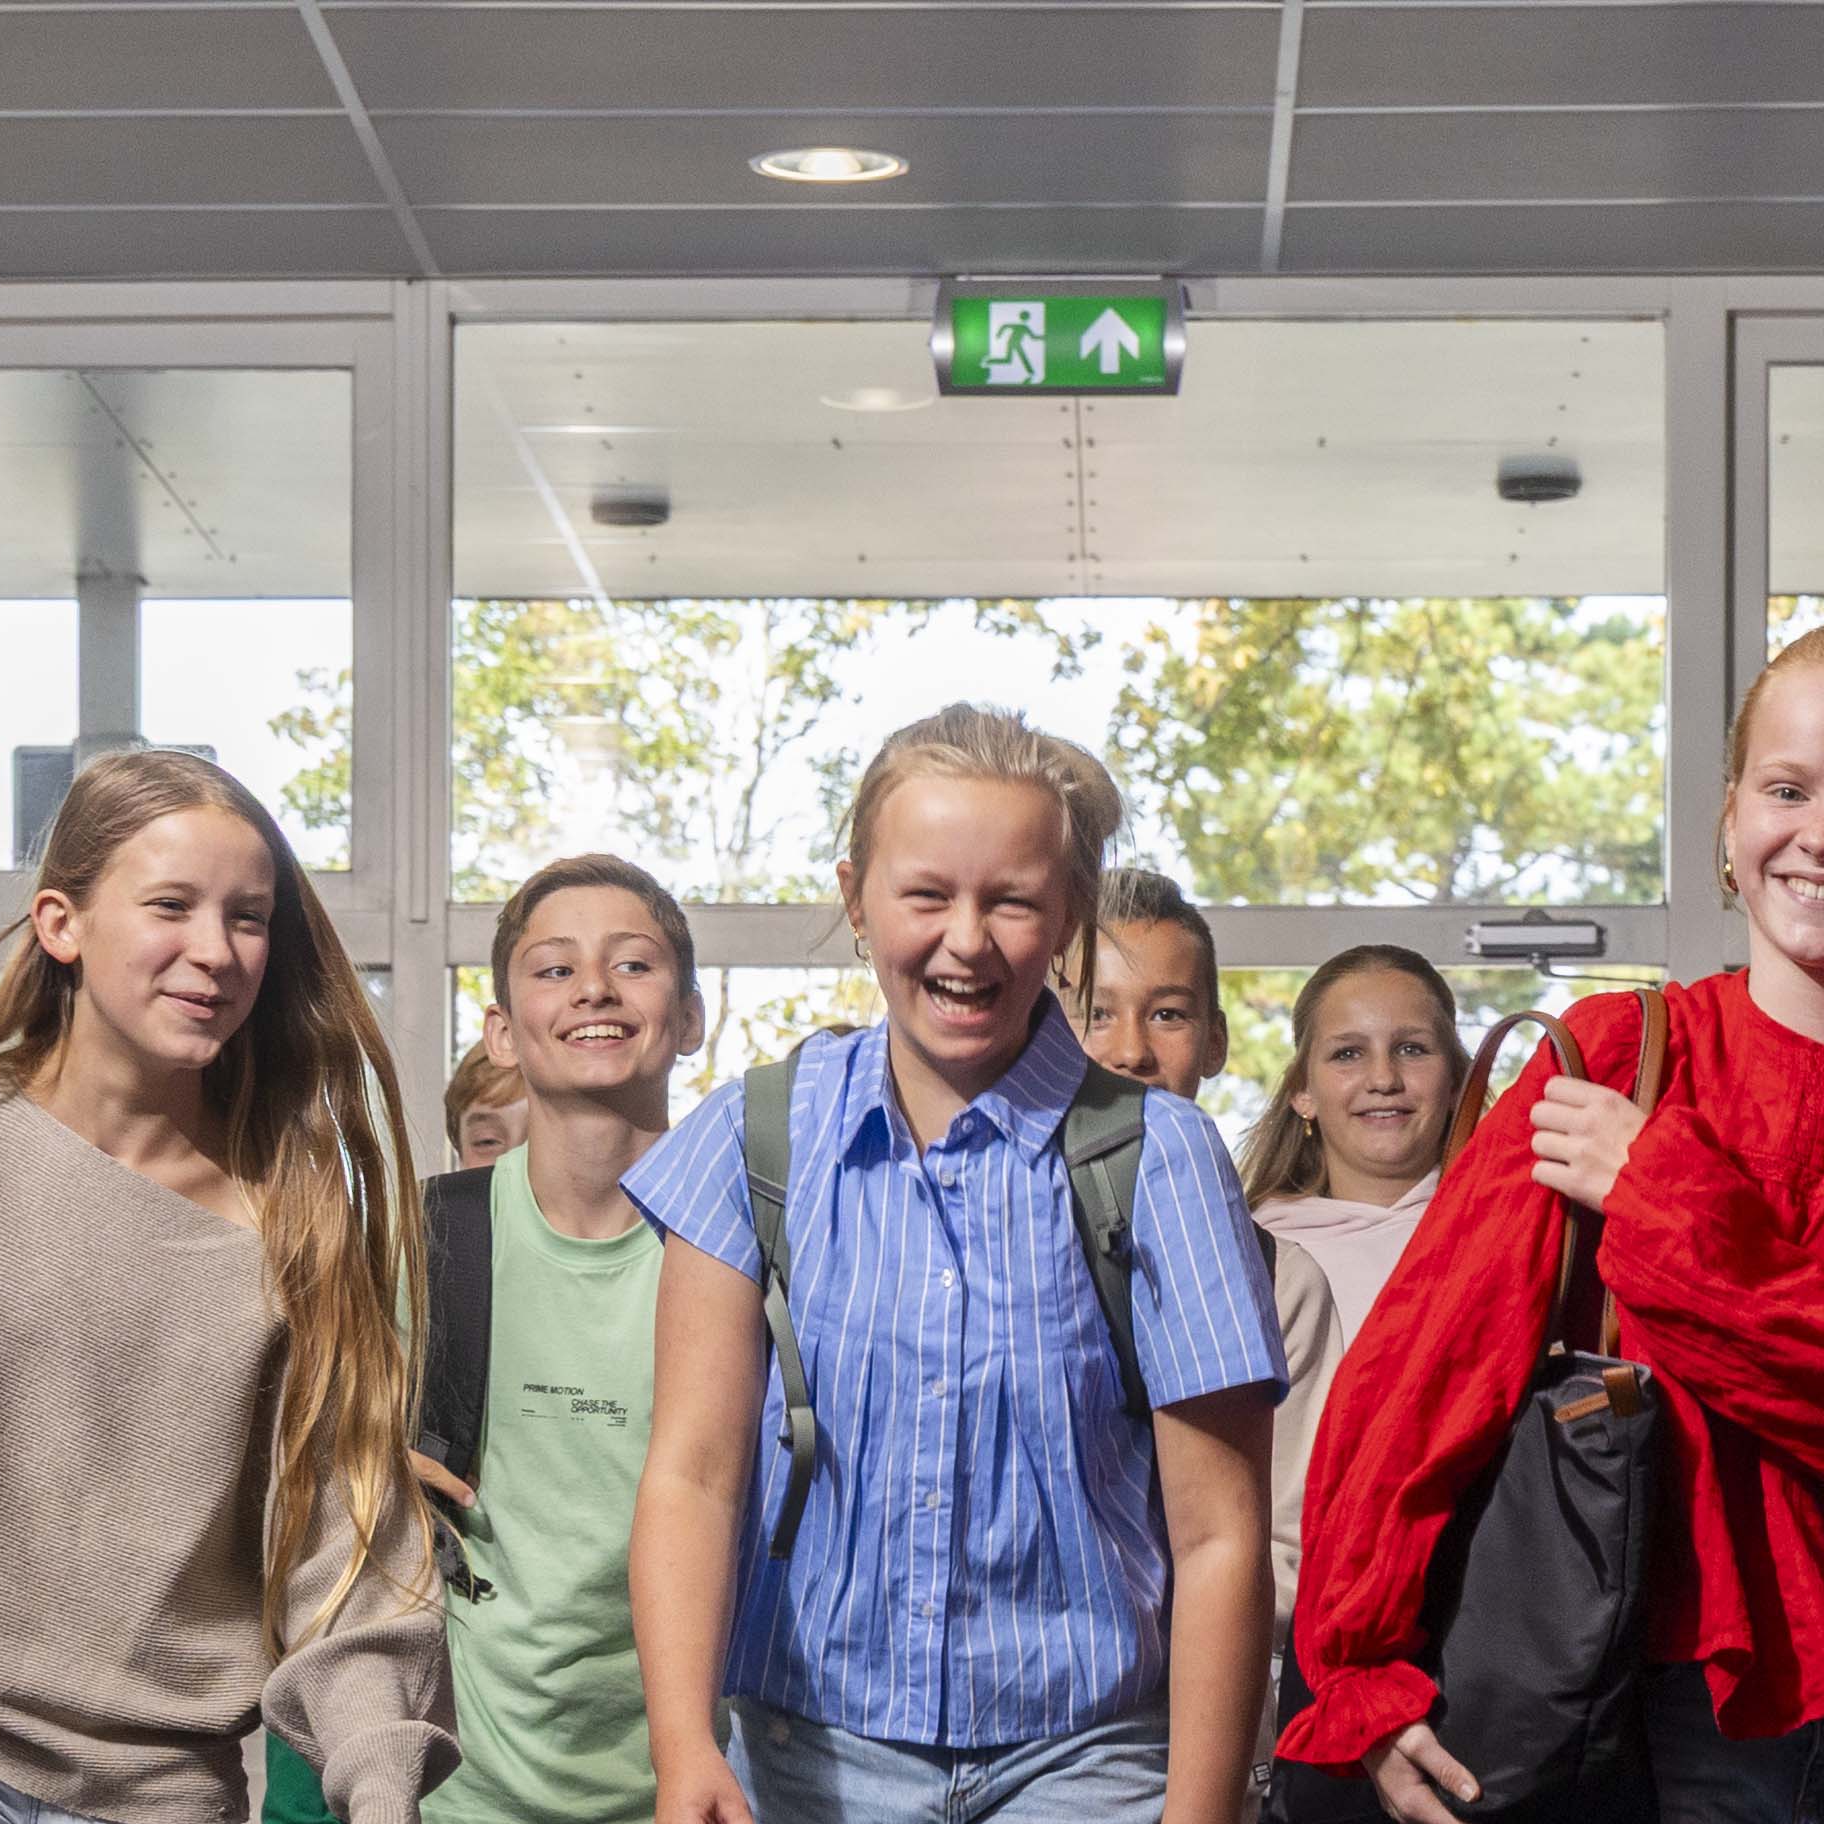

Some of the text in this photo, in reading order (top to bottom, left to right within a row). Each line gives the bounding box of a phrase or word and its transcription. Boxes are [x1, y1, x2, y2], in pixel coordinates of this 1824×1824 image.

[523, 1384, 584, 1396] PRIME MOTION
[571, 1399, 617, 1408] CHASE THE
[570, 1406, 628, 1415] OPPORTUNITY
